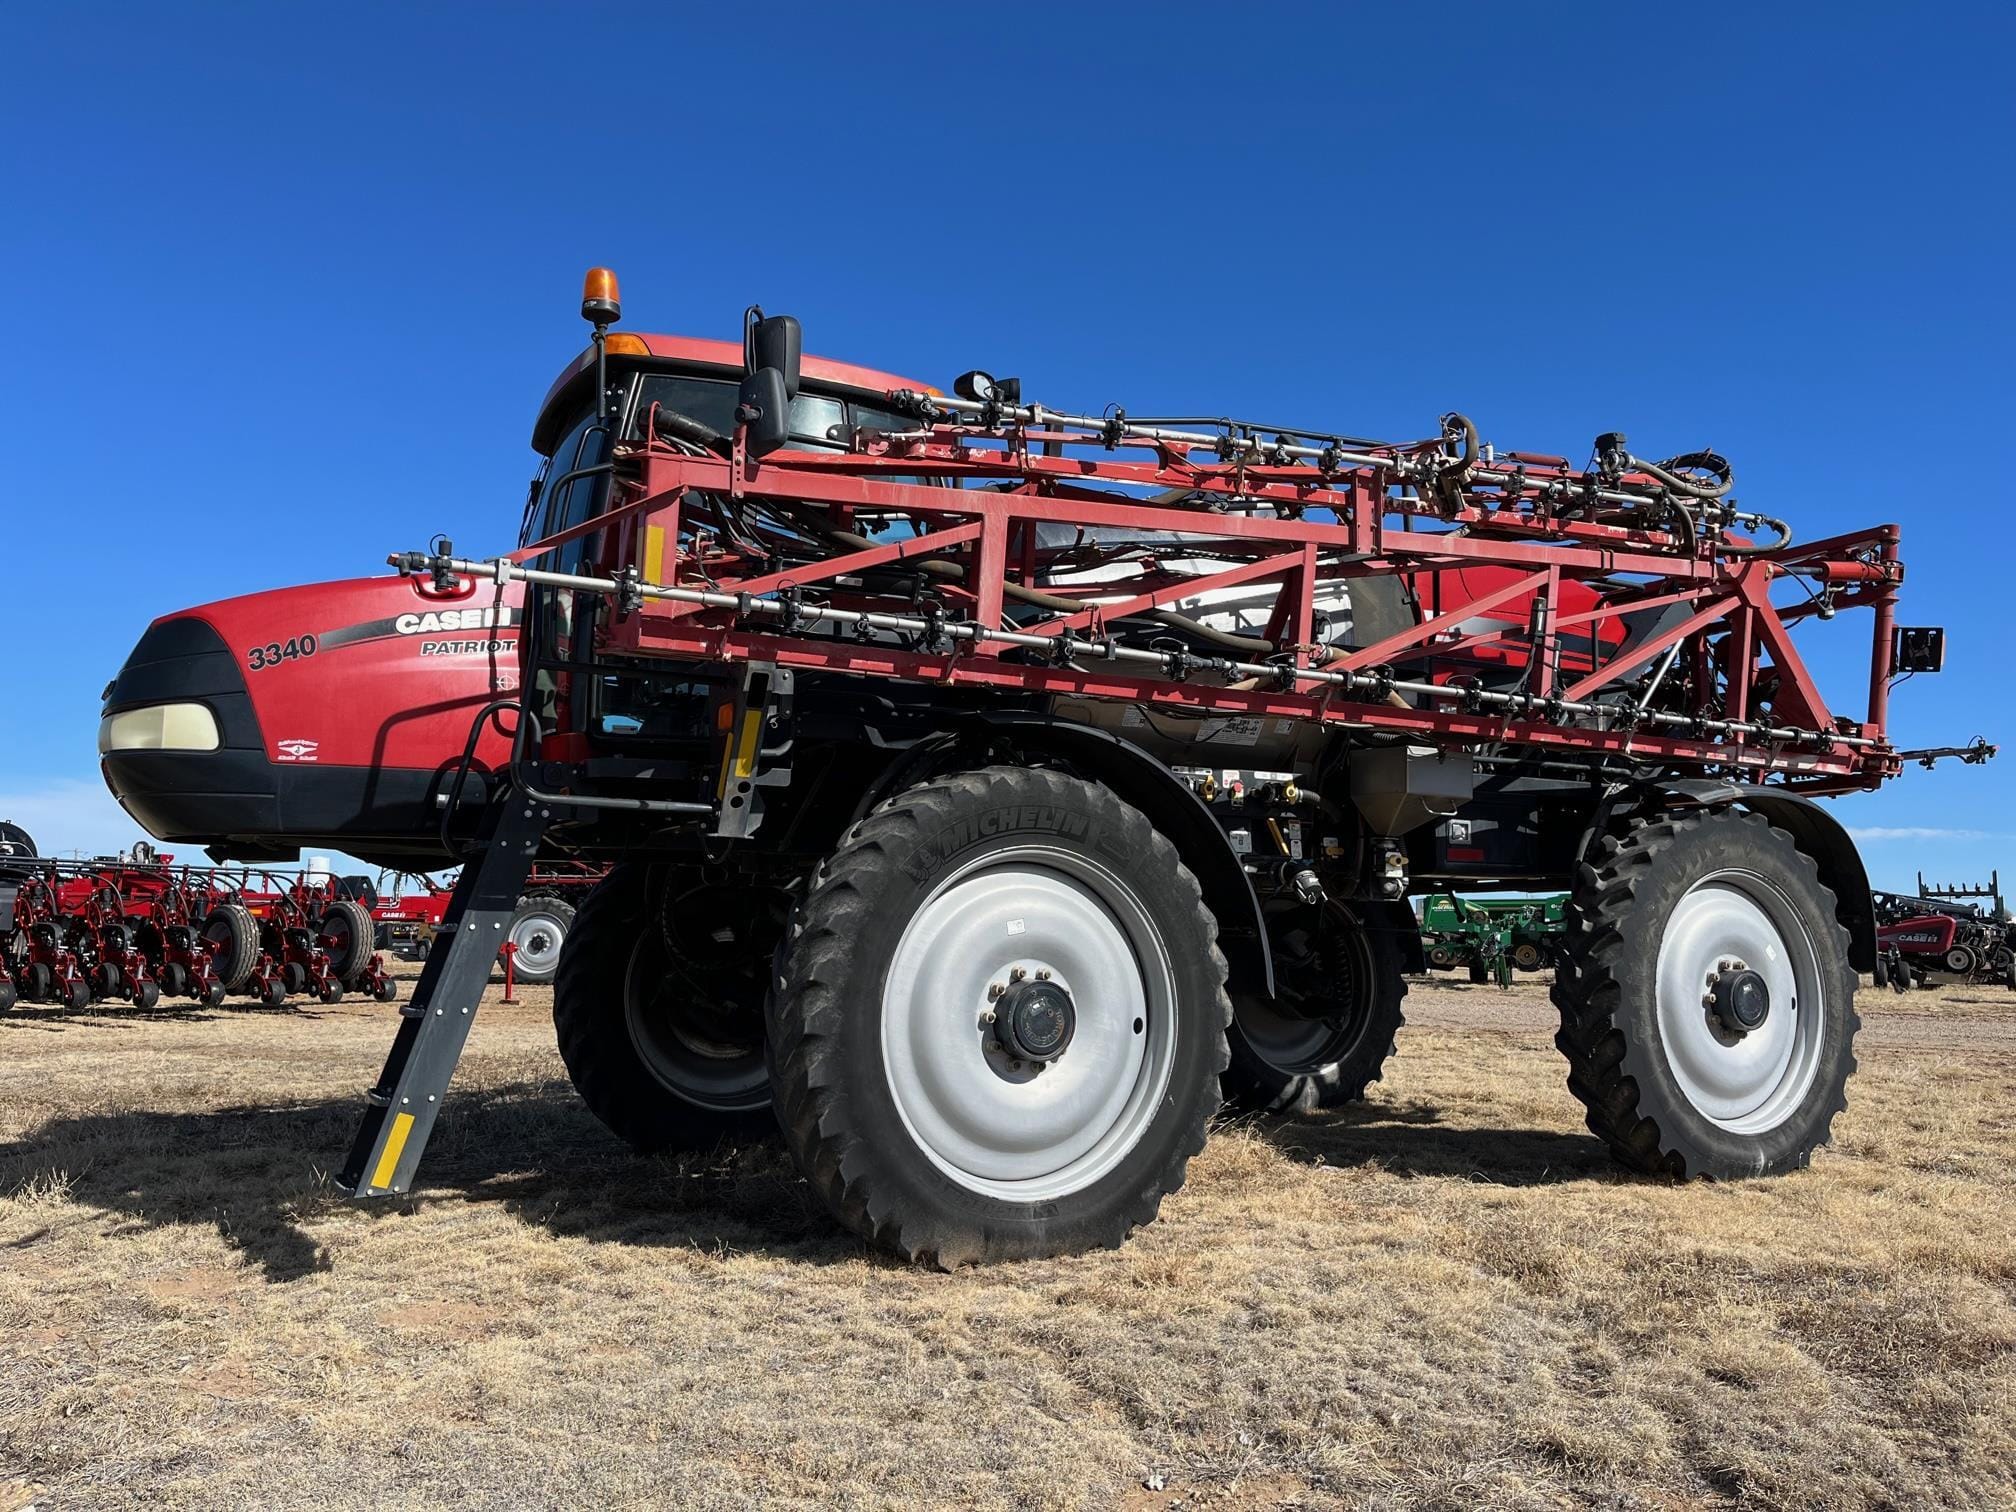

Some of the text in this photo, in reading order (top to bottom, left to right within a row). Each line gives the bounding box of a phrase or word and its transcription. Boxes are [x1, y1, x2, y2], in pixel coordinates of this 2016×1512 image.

[248, 634, 317, 671] 3340
[421, 639, 517, 655] PATRIOT
[941, 807, 1090, 854] MICHELIN
